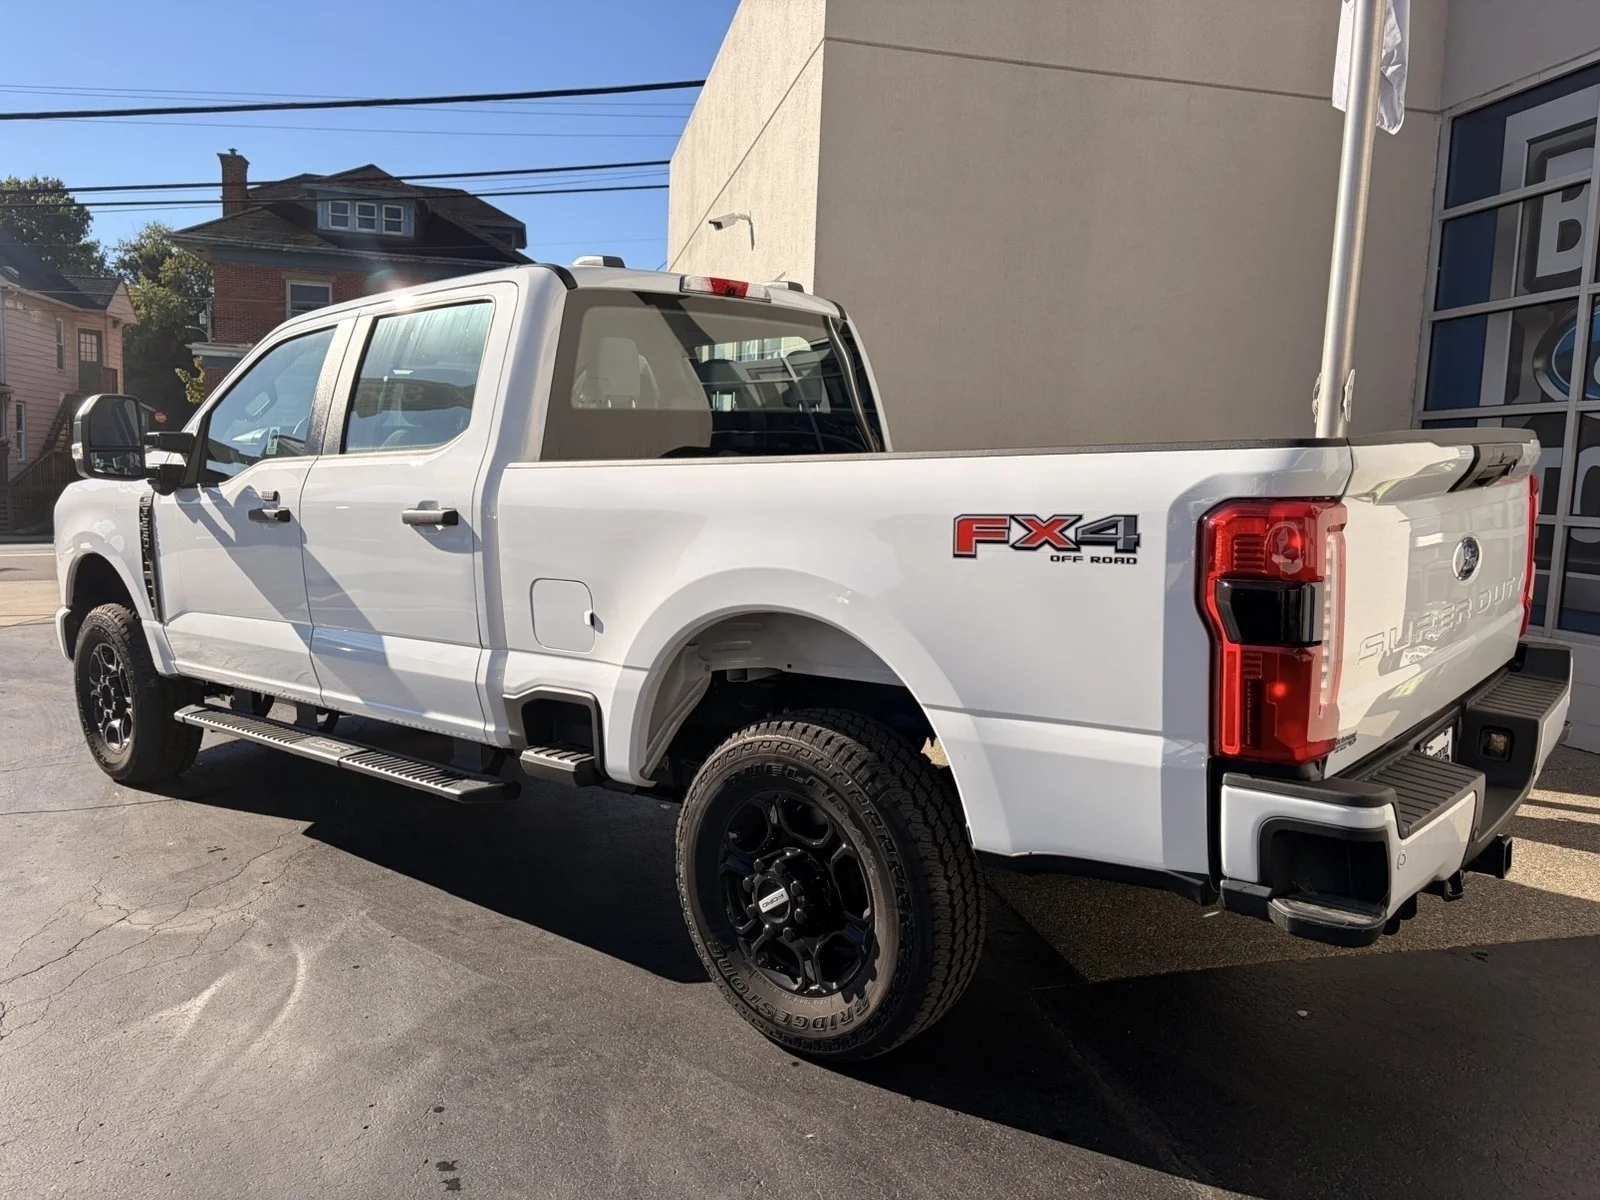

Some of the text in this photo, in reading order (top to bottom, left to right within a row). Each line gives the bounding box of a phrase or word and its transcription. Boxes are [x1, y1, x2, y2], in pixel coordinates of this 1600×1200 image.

[953, 513, 1140, 559] FX4
[1050, 555, 1138, 565] OFF ROAD
[1358, 598, 1474, 662] SUPER
[725, 762, 849, 818] DUELER
[762, 894, 785, 908] FORD
[706, 941, 871, 1032] BRIDGESTONE
